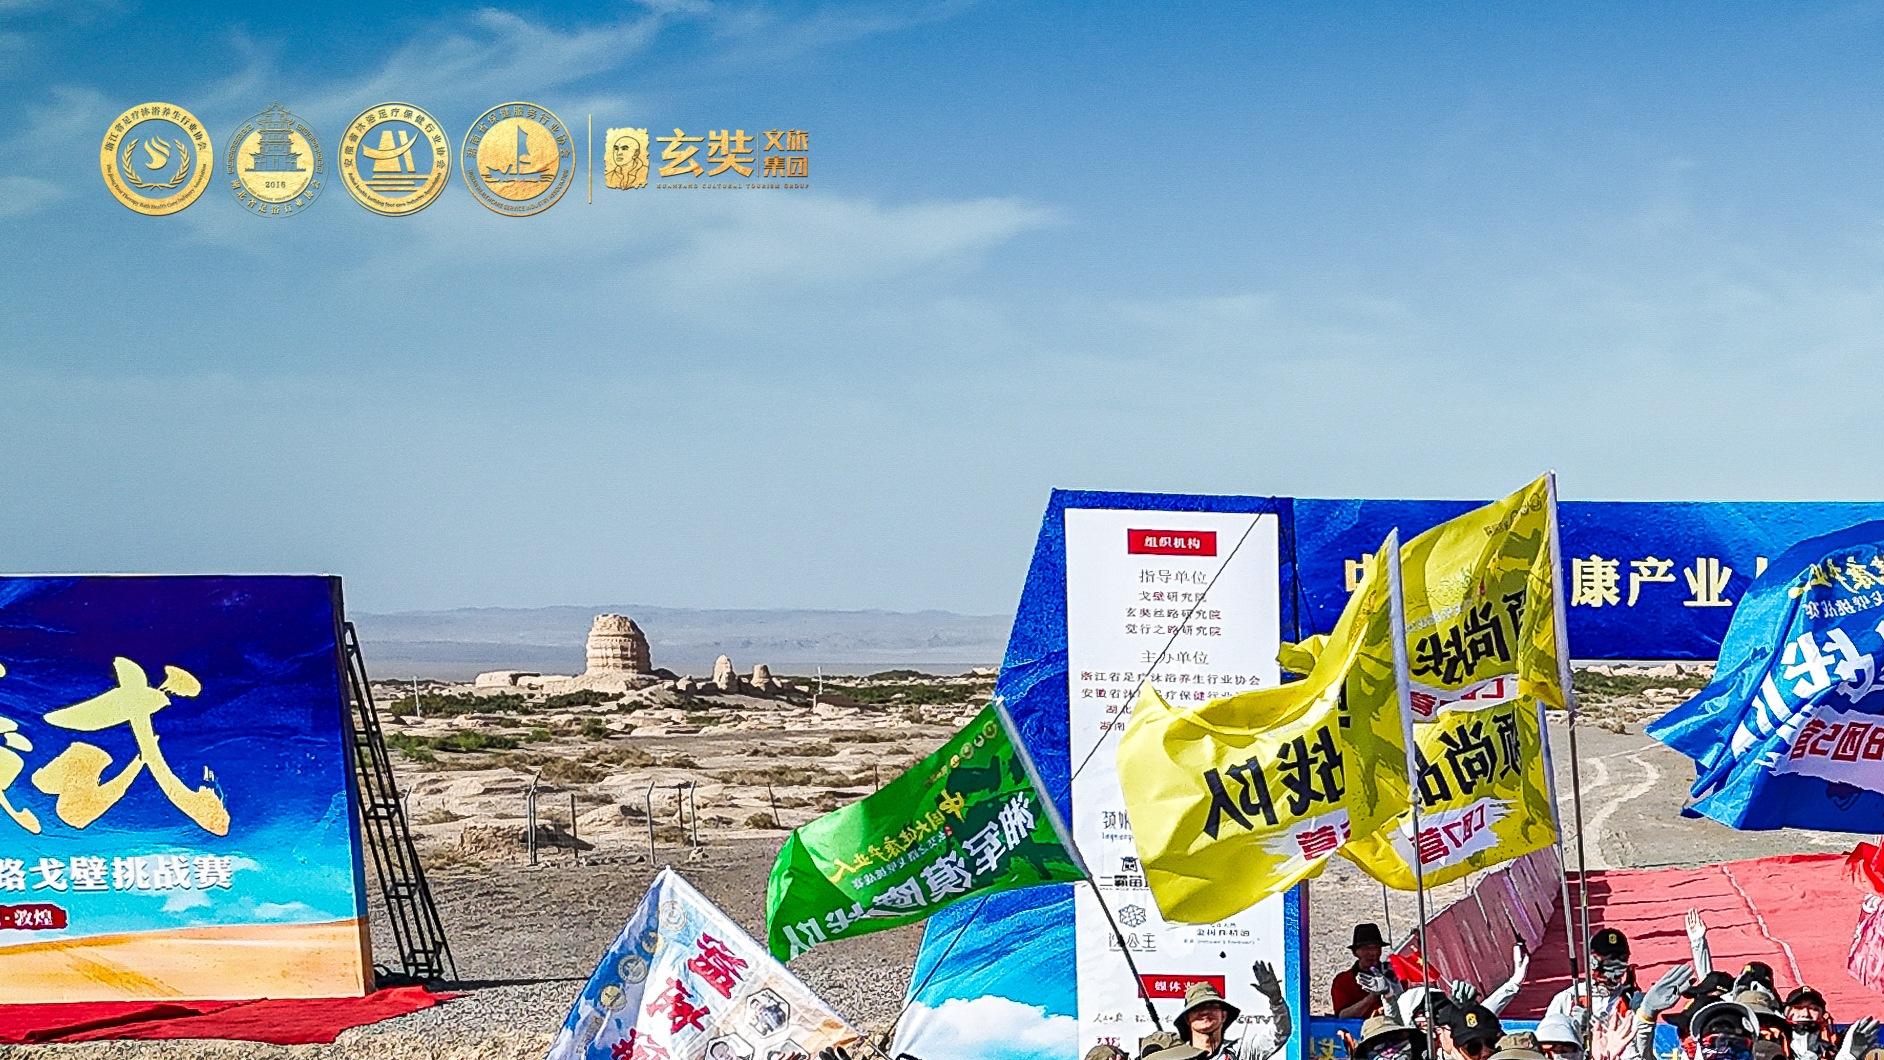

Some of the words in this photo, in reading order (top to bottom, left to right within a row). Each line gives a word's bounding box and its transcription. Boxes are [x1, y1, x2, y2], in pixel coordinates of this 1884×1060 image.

[1138, 569, 1208, 586] 指导单位
[1140, 649, 1210, 665] 主办单位
